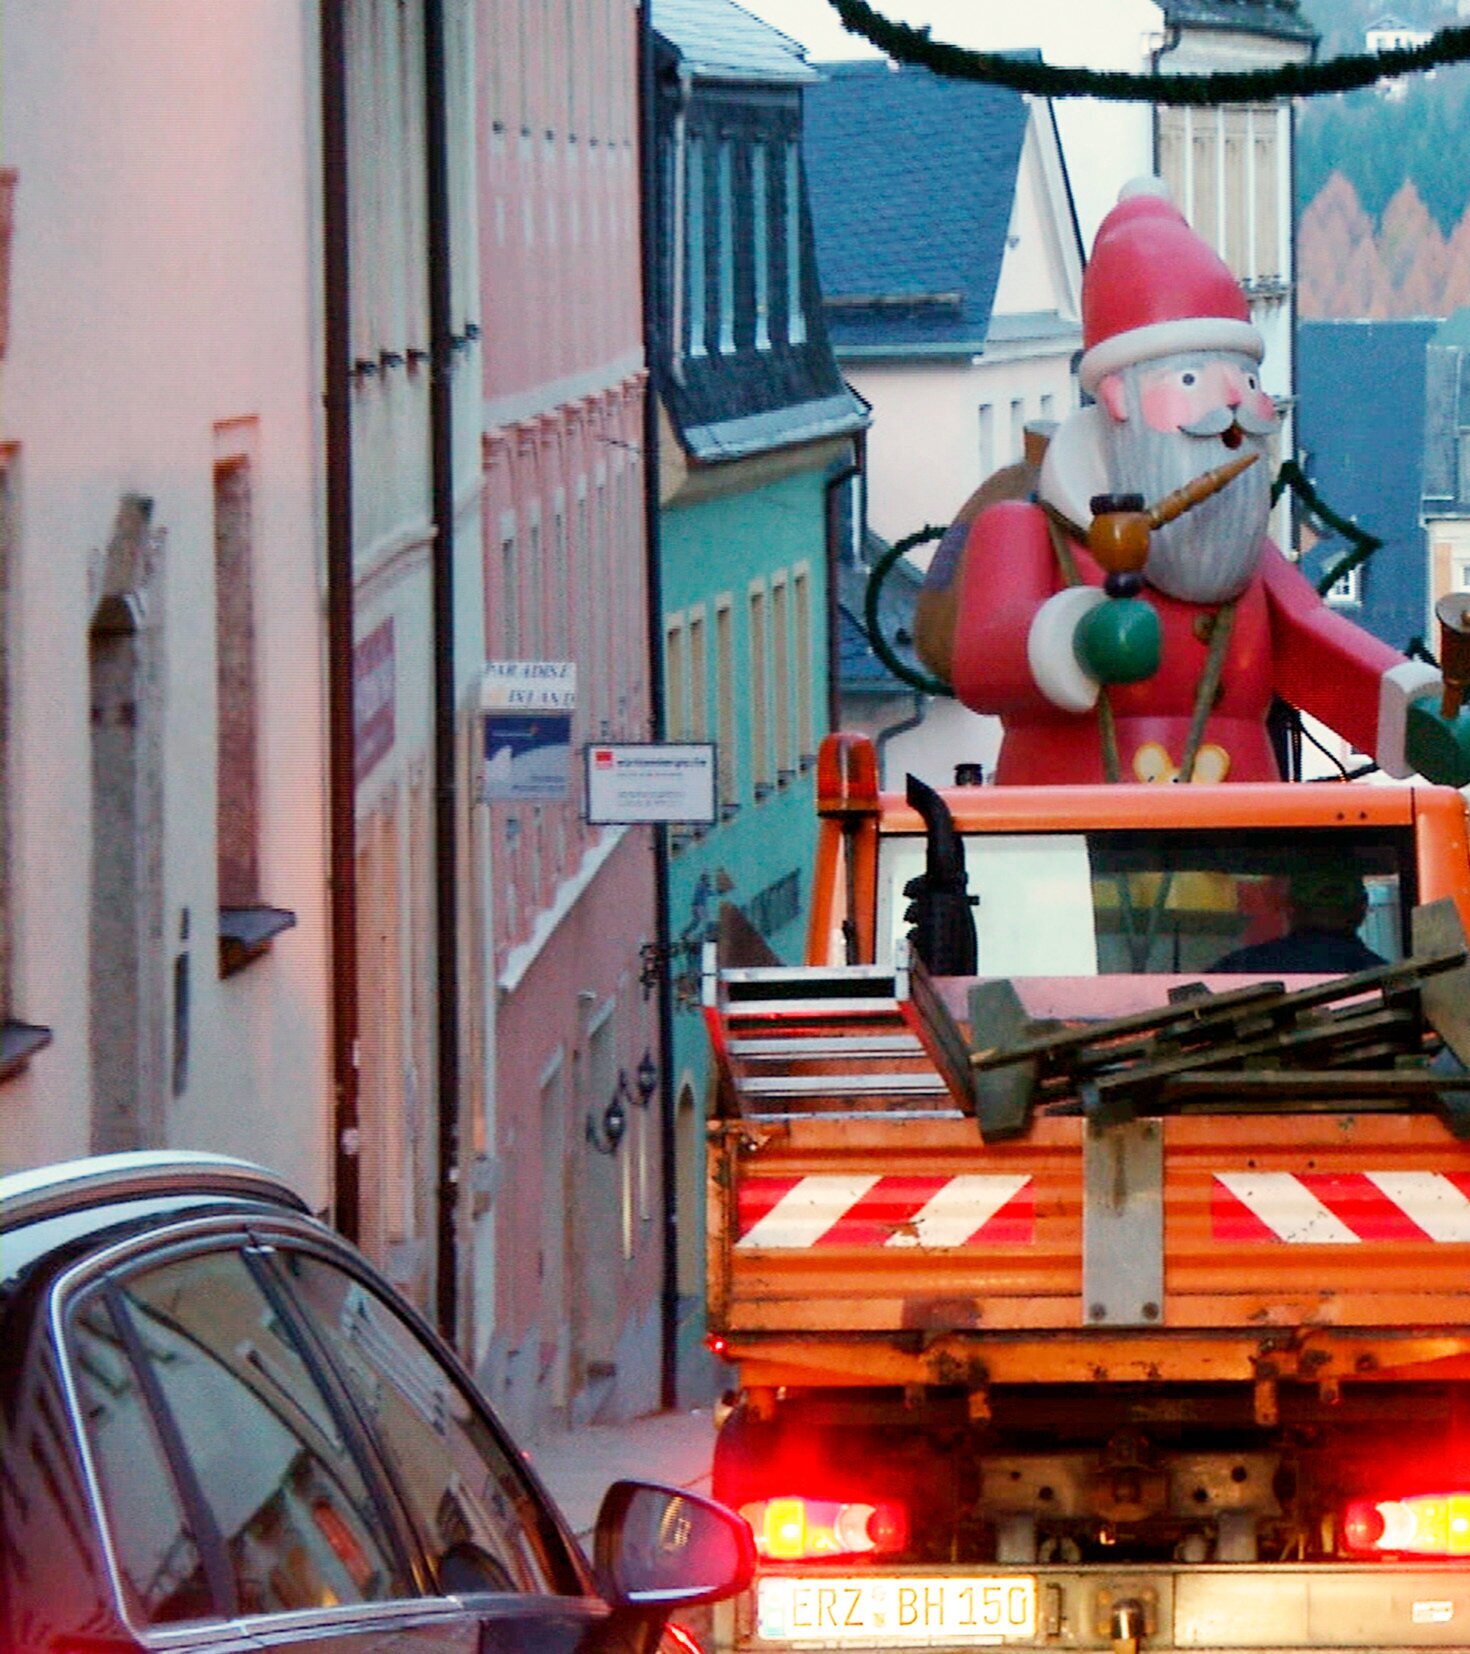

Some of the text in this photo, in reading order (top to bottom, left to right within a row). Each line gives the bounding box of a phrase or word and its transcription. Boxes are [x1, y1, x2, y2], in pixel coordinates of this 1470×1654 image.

[792, 1585, 1027, 1627] ERZ BH 150
